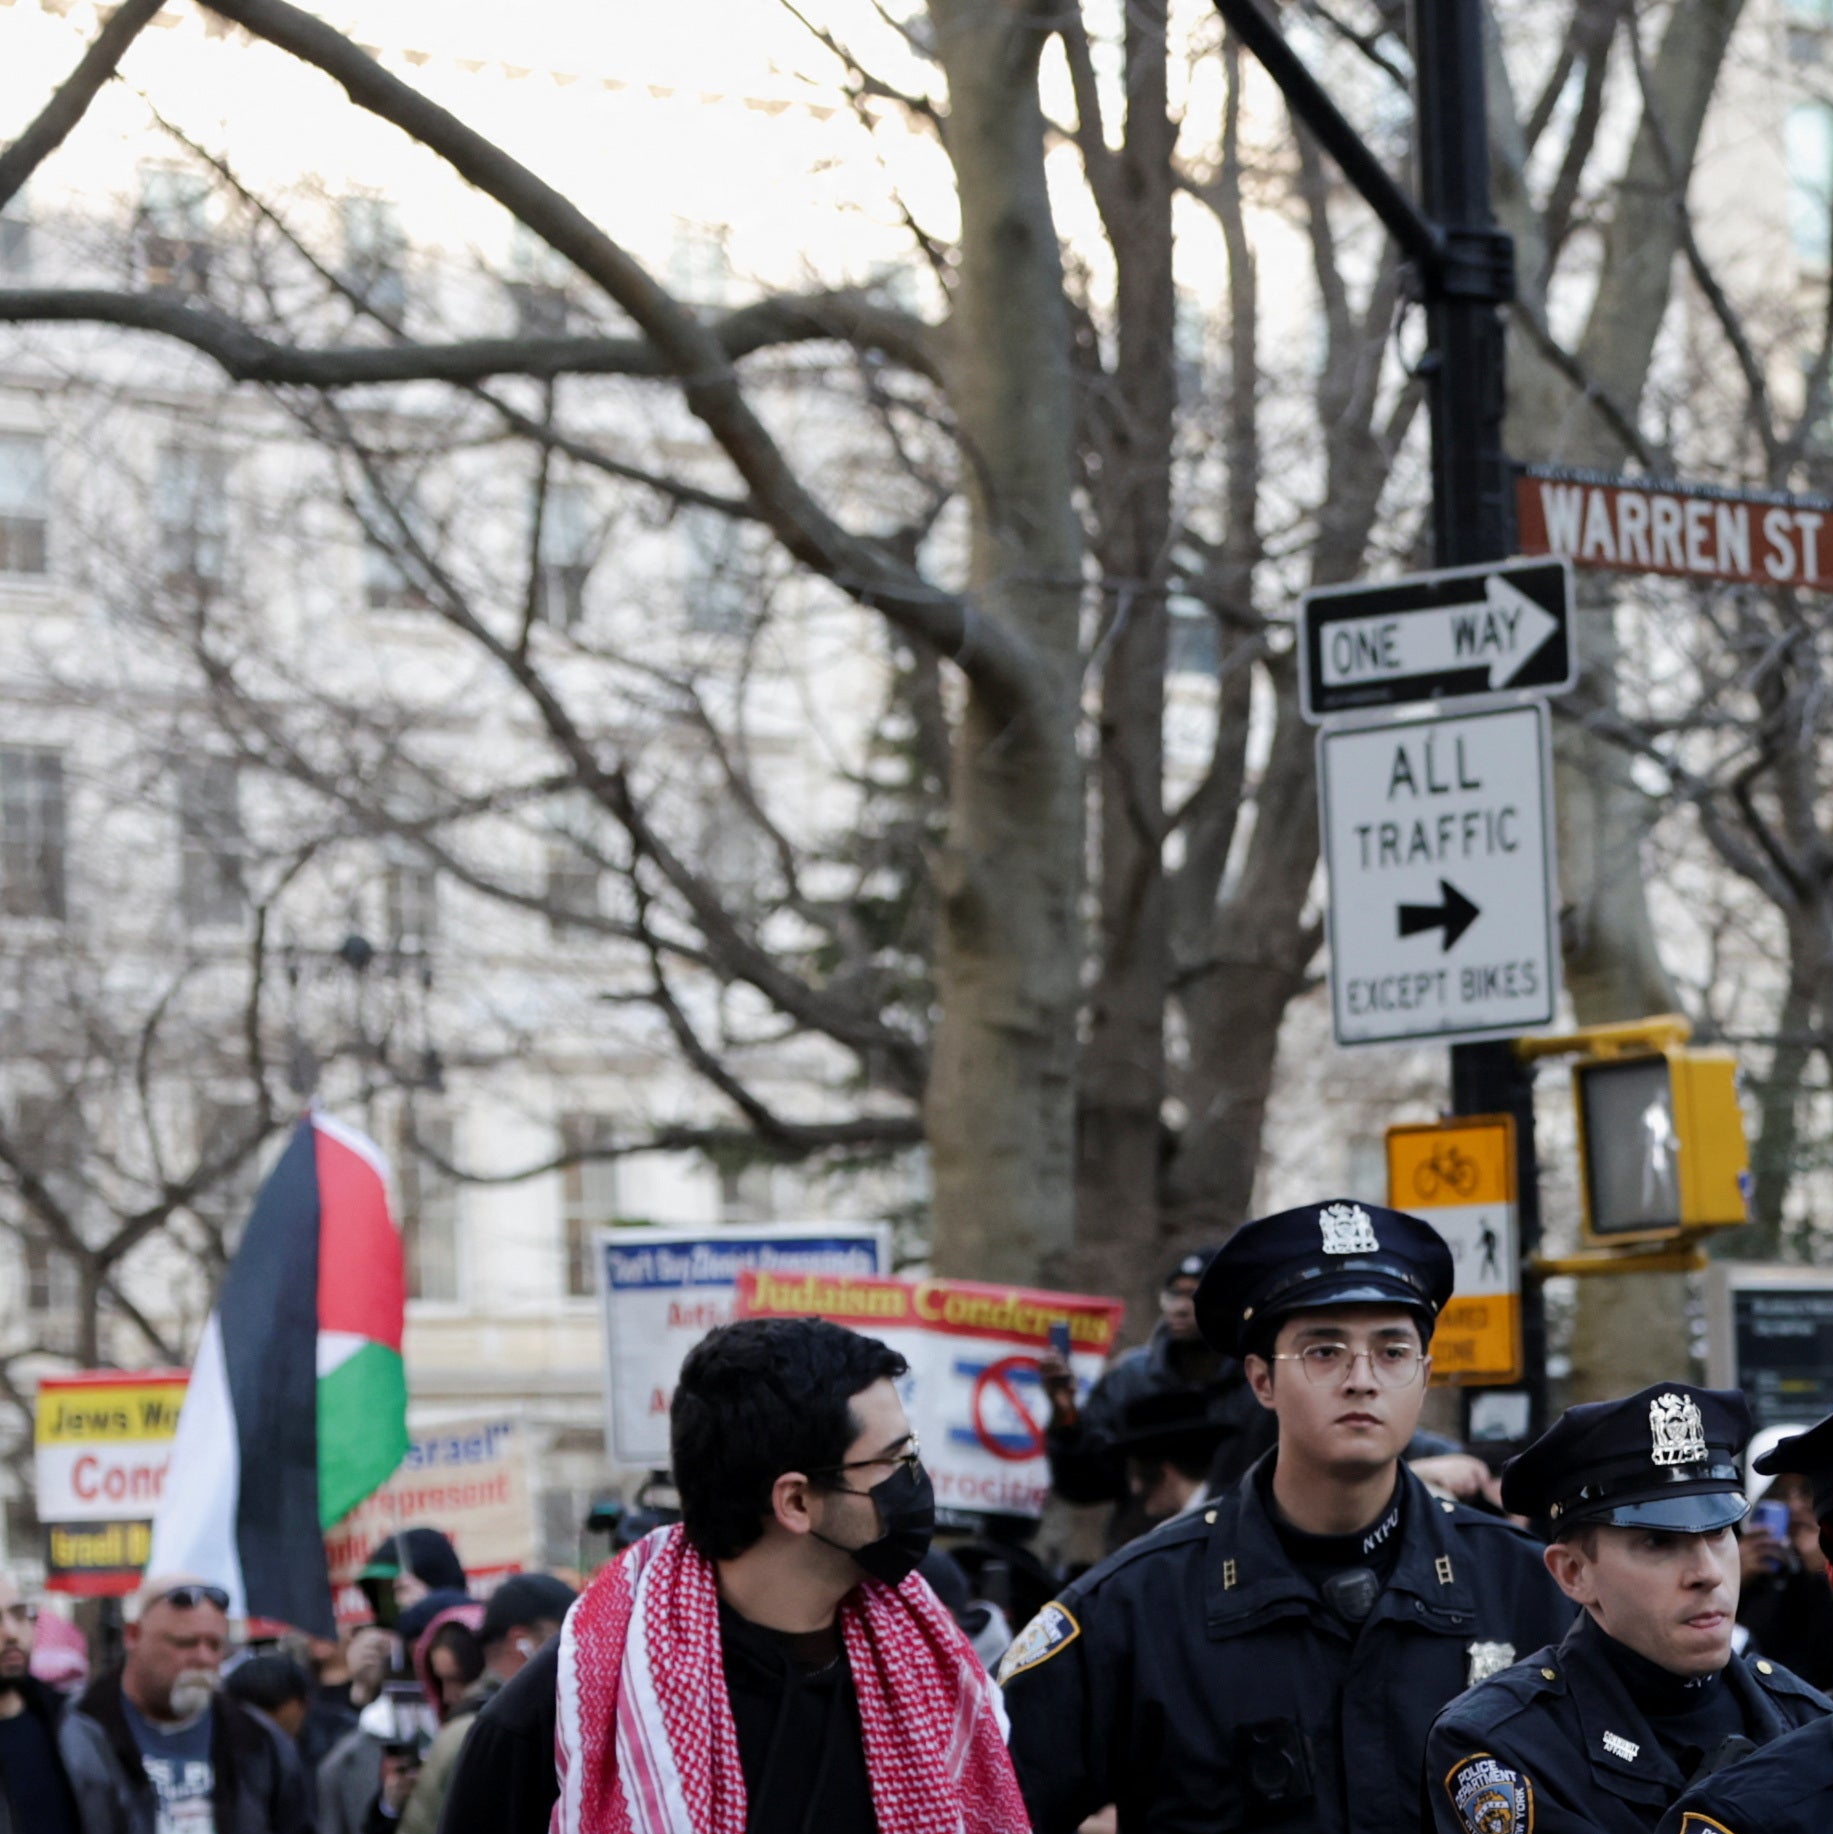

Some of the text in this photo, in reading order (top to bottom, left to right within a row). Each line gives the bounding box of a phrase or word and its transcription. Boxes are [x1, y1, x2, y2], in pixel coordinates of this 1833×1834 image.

[1540, 482, 1749, 575] WARREN
[1763, 507, 1823, 583] ST
[1332, 608, 1526, 675] ONE WAY
[1387, 736, 1482, 800] ALL
[1354, 807, 1519, 871] TRAFFIC
[1348, 959, 1537, 1015] EXCEPT BIKES
[750, 1271, 1109, 1344] Judaism Condemns
[50, 1404, 129, 1438] Jews
[1455, 1769, 1517, 1810] DEPARTMENT
[1457, 1759, 1498, 1785] POLICE
[1515, 1787, 1526, 1819] YORK
